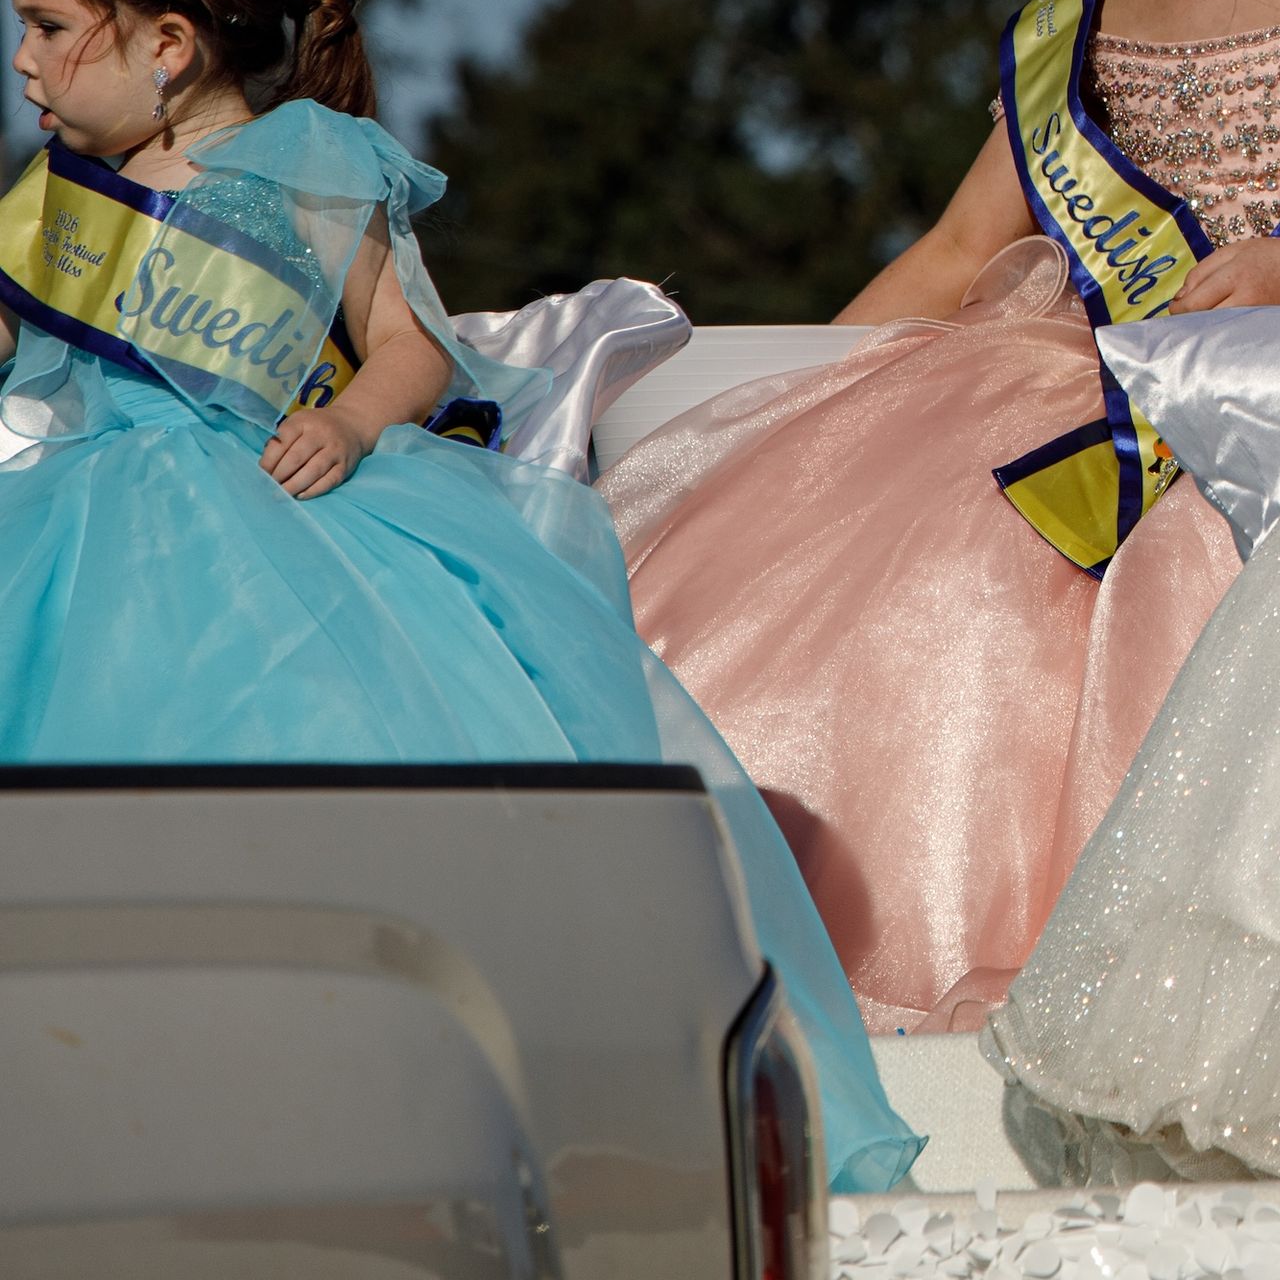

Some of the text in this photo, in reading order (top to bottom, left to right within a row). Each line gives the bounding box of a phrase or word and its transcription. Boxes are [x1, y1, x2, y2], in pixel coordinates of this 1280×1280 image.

[61, 235, 107, 266] Festival
[1032, 112, 1178, 306] Swedish
[56, 254, 83, 278] Miss
[114, 247, 337, 409] Swedish
